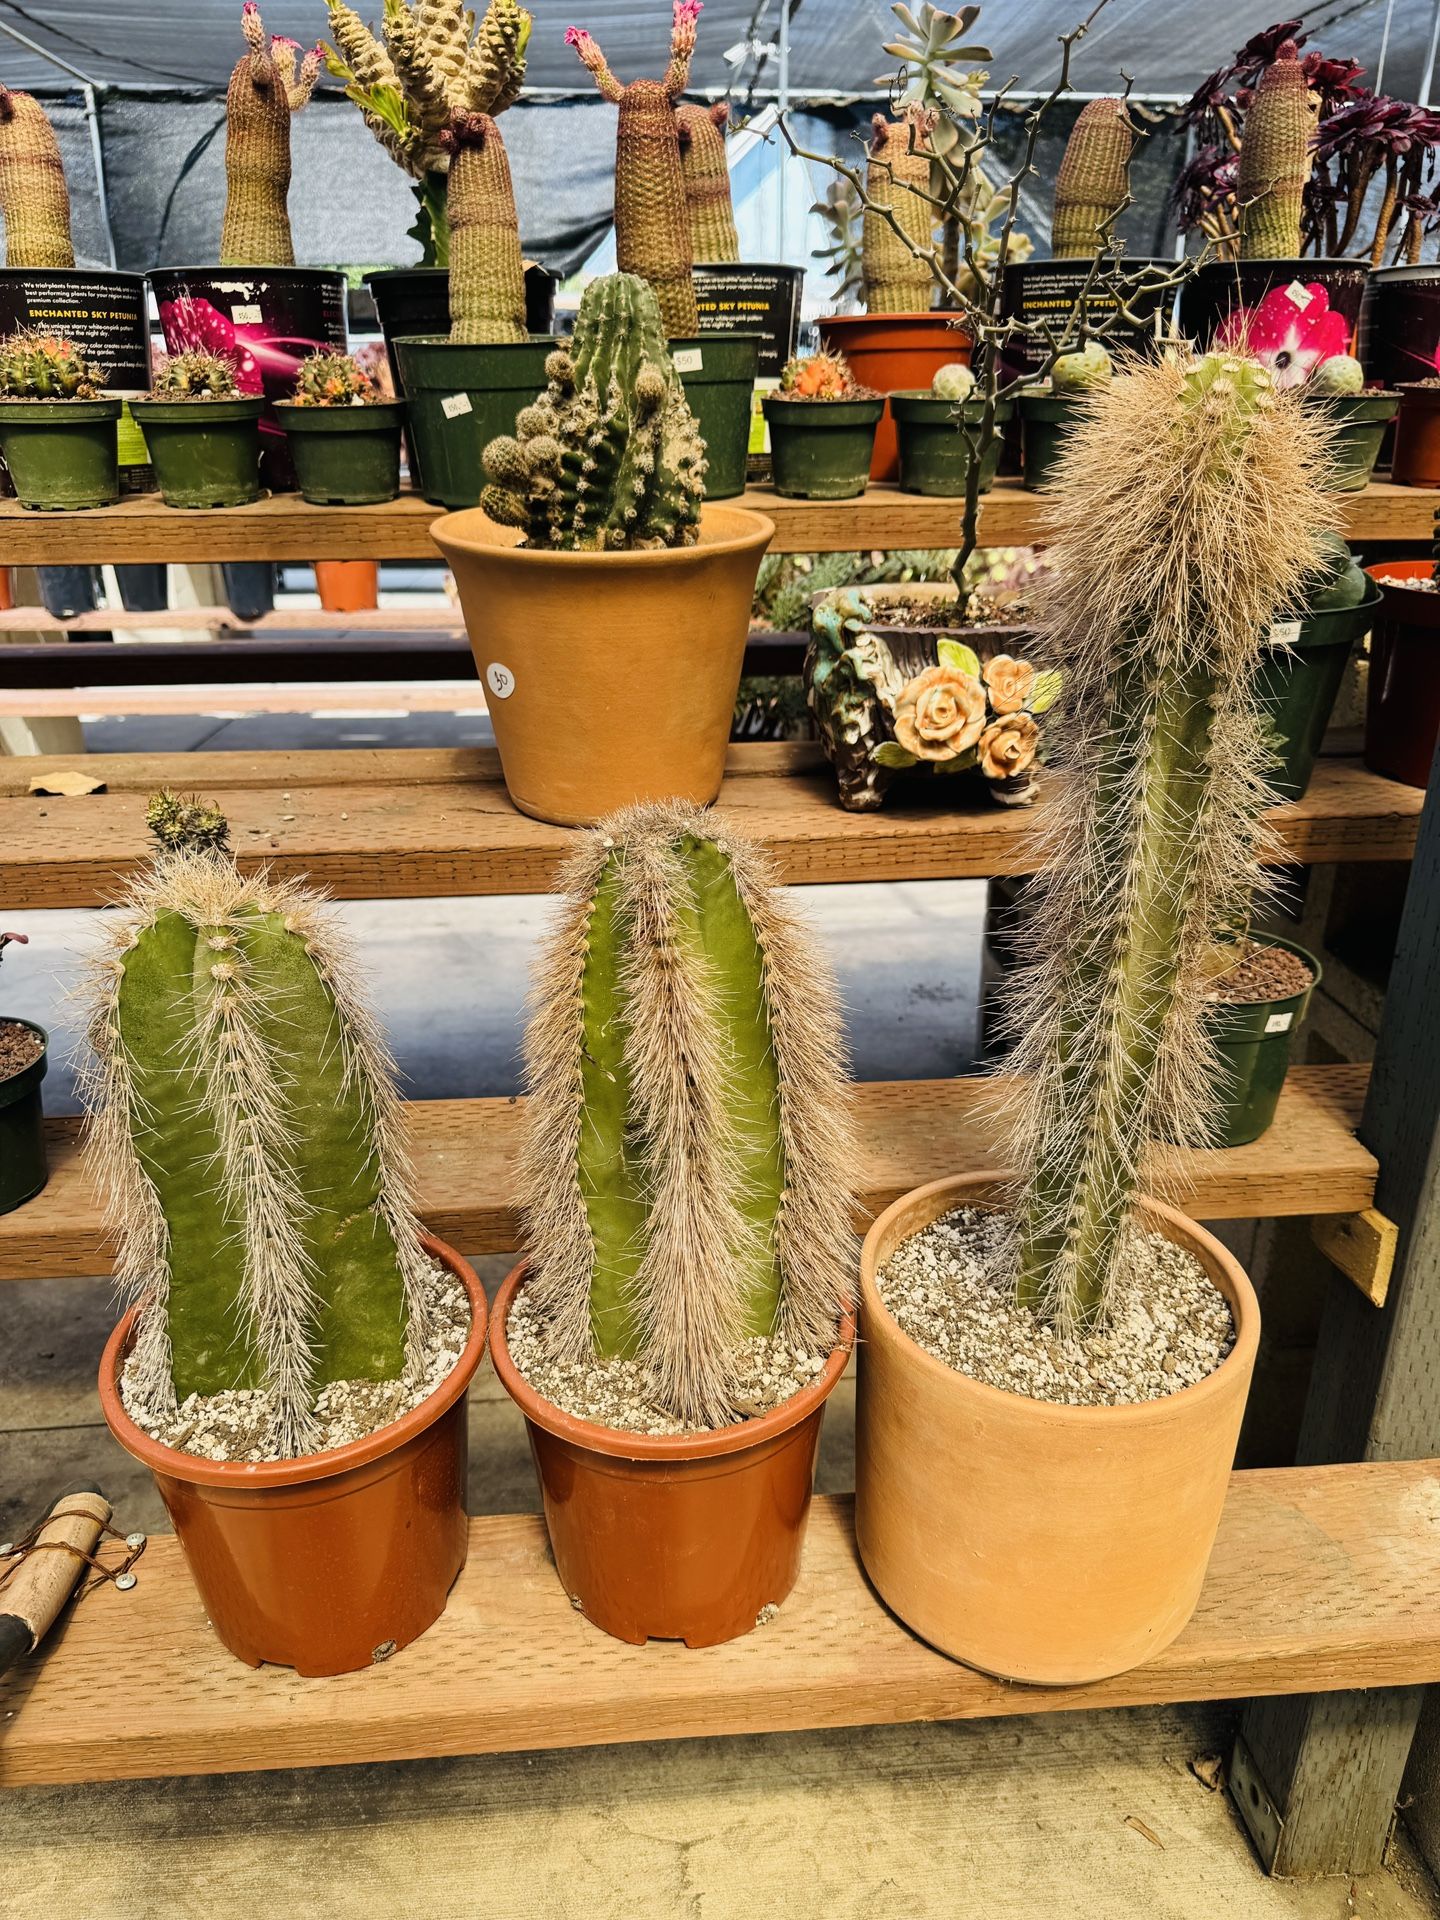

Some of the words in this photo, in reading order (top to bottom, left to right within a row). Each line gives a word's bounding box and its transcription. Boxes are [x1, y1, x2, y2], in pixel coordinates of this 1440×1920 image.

[38, 289, 70, 298] performing
[70, 290, 87, 298] plants
[26, 297, 51, 305] premium
[1023, 300, 1073, 310] ENCHANTED
[718, 302, 736, 311] SKY
[737, 302, 770, 311] PETUNIA
[29, 309, 89, 318] ENCHANTED
[91, 310, 108, 319] SKY
[109, 311, 138, 320] PETUNIA
[50, 322, 71, 330] unique
[71, 323, 88, 331] starry
[85, 330, 99, 338] night
